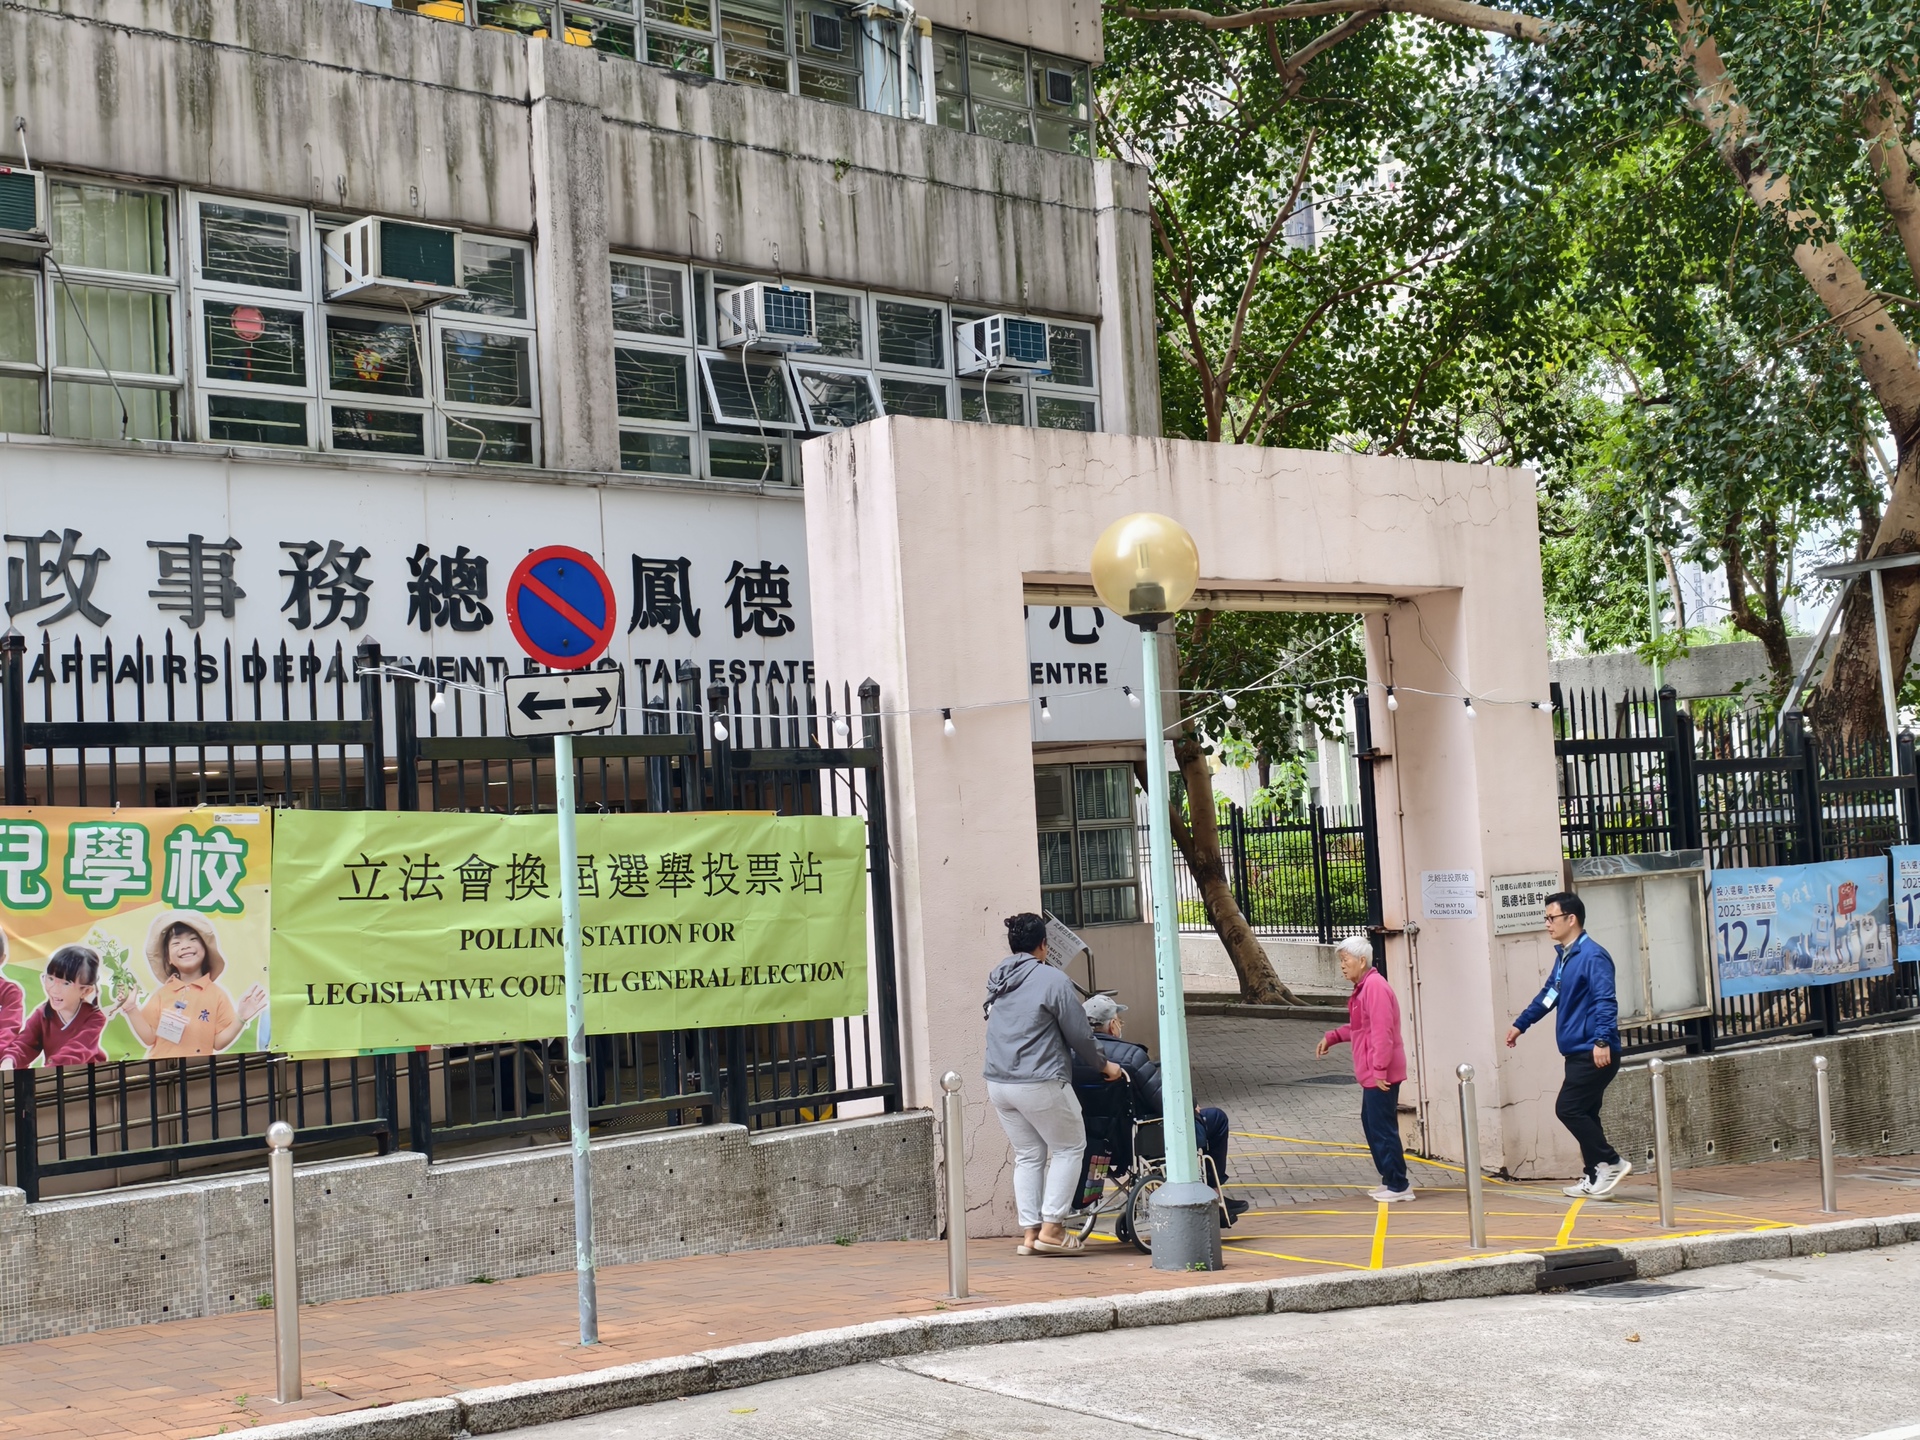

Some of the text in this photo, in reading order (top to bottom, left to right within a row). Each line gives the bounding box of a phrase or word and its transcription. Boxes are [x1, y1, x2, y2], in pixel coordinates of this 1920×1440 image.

[4, 528, 796, 638] 政事務總鳳德
[28, 654, 219, 684] AFFAIRS
[242, 655, 505, 684] DEPATMENT
[709, 659, 815, 684] ESTATE
[338, 852, 822, 902] 立法會換屆選舉投票站
[582, 923, 682, 947] STATION
[689, 922, 736, 943] FOR
[305, 977, 494, 1006] LEGISLATIVE
[621, 967, 736, 993] GENERAL
[740, 961, 845, 986] ELECTION
